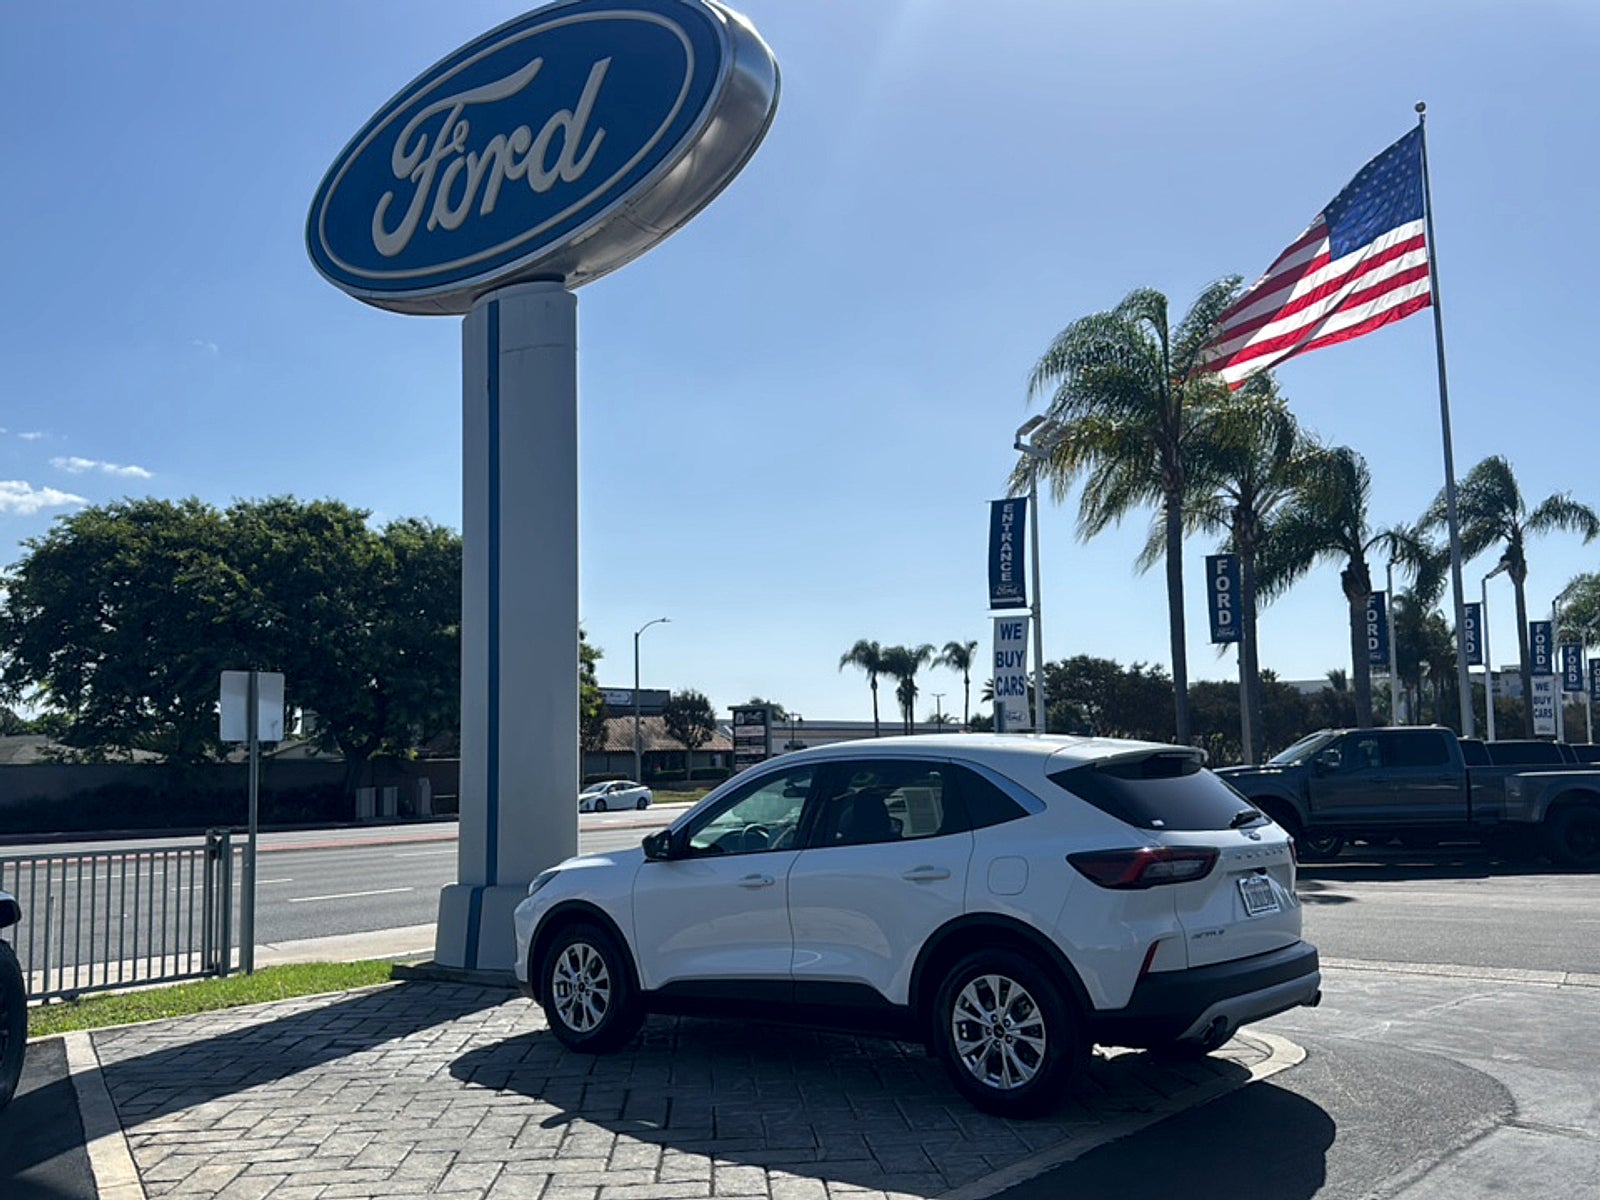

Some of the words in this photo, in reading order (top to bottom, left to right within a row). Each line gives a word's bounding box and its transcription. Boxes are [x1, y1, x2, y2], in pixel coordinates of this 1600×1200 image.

[372, 56, 612, 258] Ford
[1000, 503, 1014, 581] ENTRANCE
[1216, 559, 1232, 625] FORD
[1000, 623, 1022, 640] WE
[1366, 595, 1379, 650] FORD
[1464, 606, 1475, 653] FORD
[996, 650, 1025, 668] BUY
[1535, 623, 1546, 665] FORD
[1568, 646, 1578, 683] FORD
[996, 676, 1025, 696] CARS
[1534, 696, 1551, 705] BUY
[1535, 681, 1549, 691] WE
[1534, 708, 1553, 718] CARS
